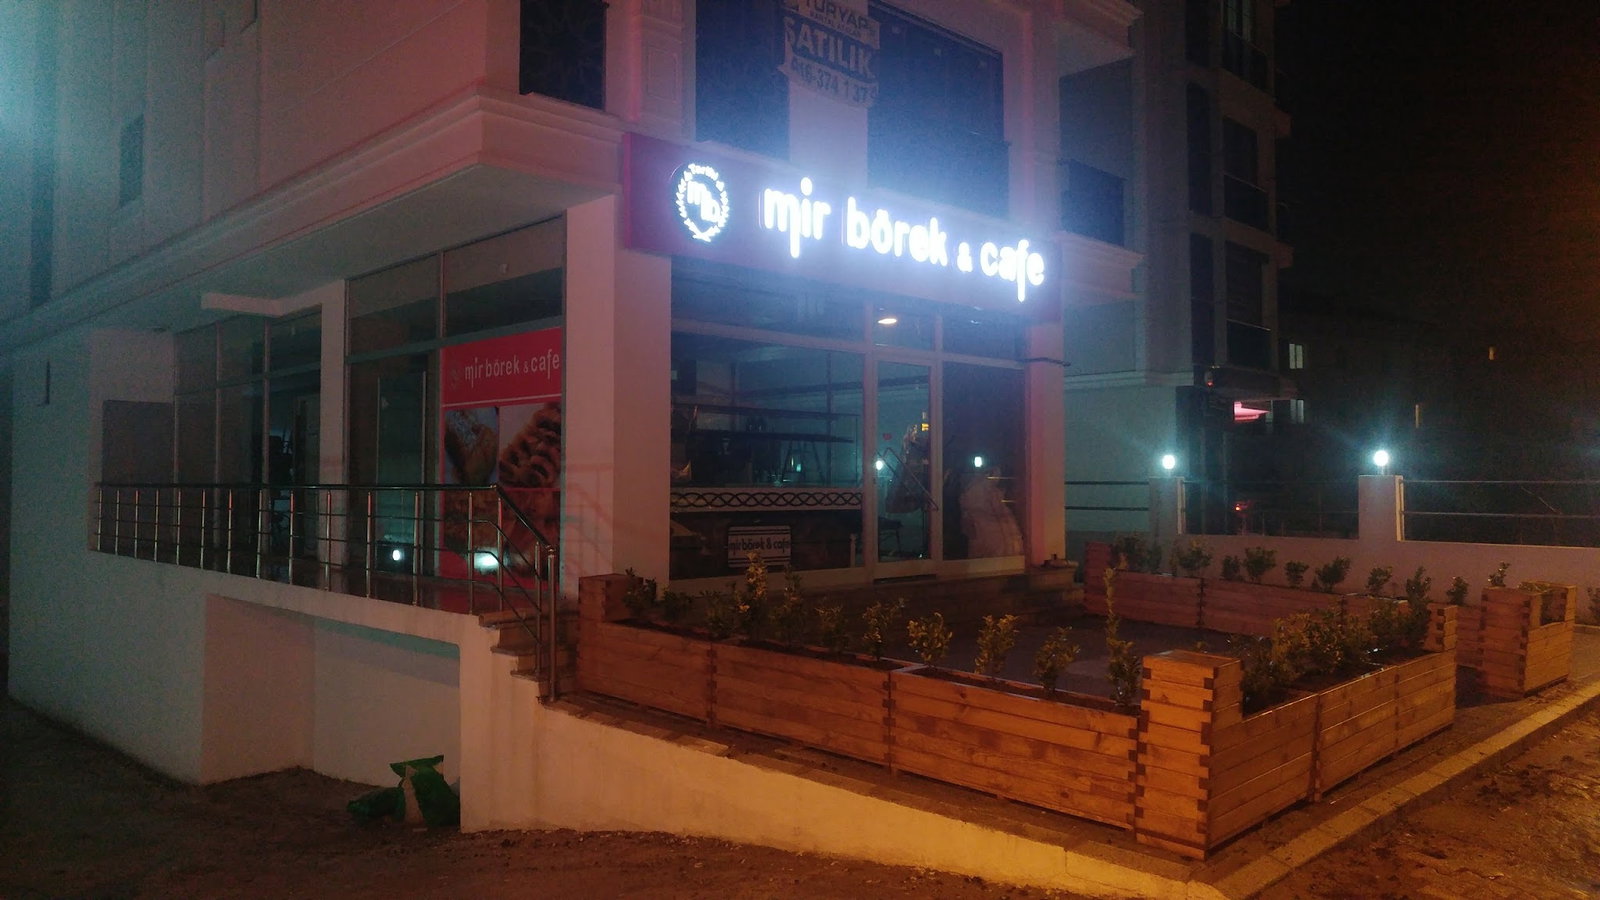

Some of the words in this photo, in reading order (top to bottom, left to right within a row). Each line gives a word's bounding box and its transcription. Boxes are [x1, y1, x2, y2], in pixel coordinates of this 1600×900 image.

[783, 16, 876, 79] SATILIK
[763, 176, 832, 258] mir
[846, 197, 948, 267] börek
[957, 242, 973, 273] &
[980, 239, 1045, 302] cafe
[465, 357, 483, 388] mir
[523, 361, 529, 374] &
[530, 348, 560, 380] cafe
